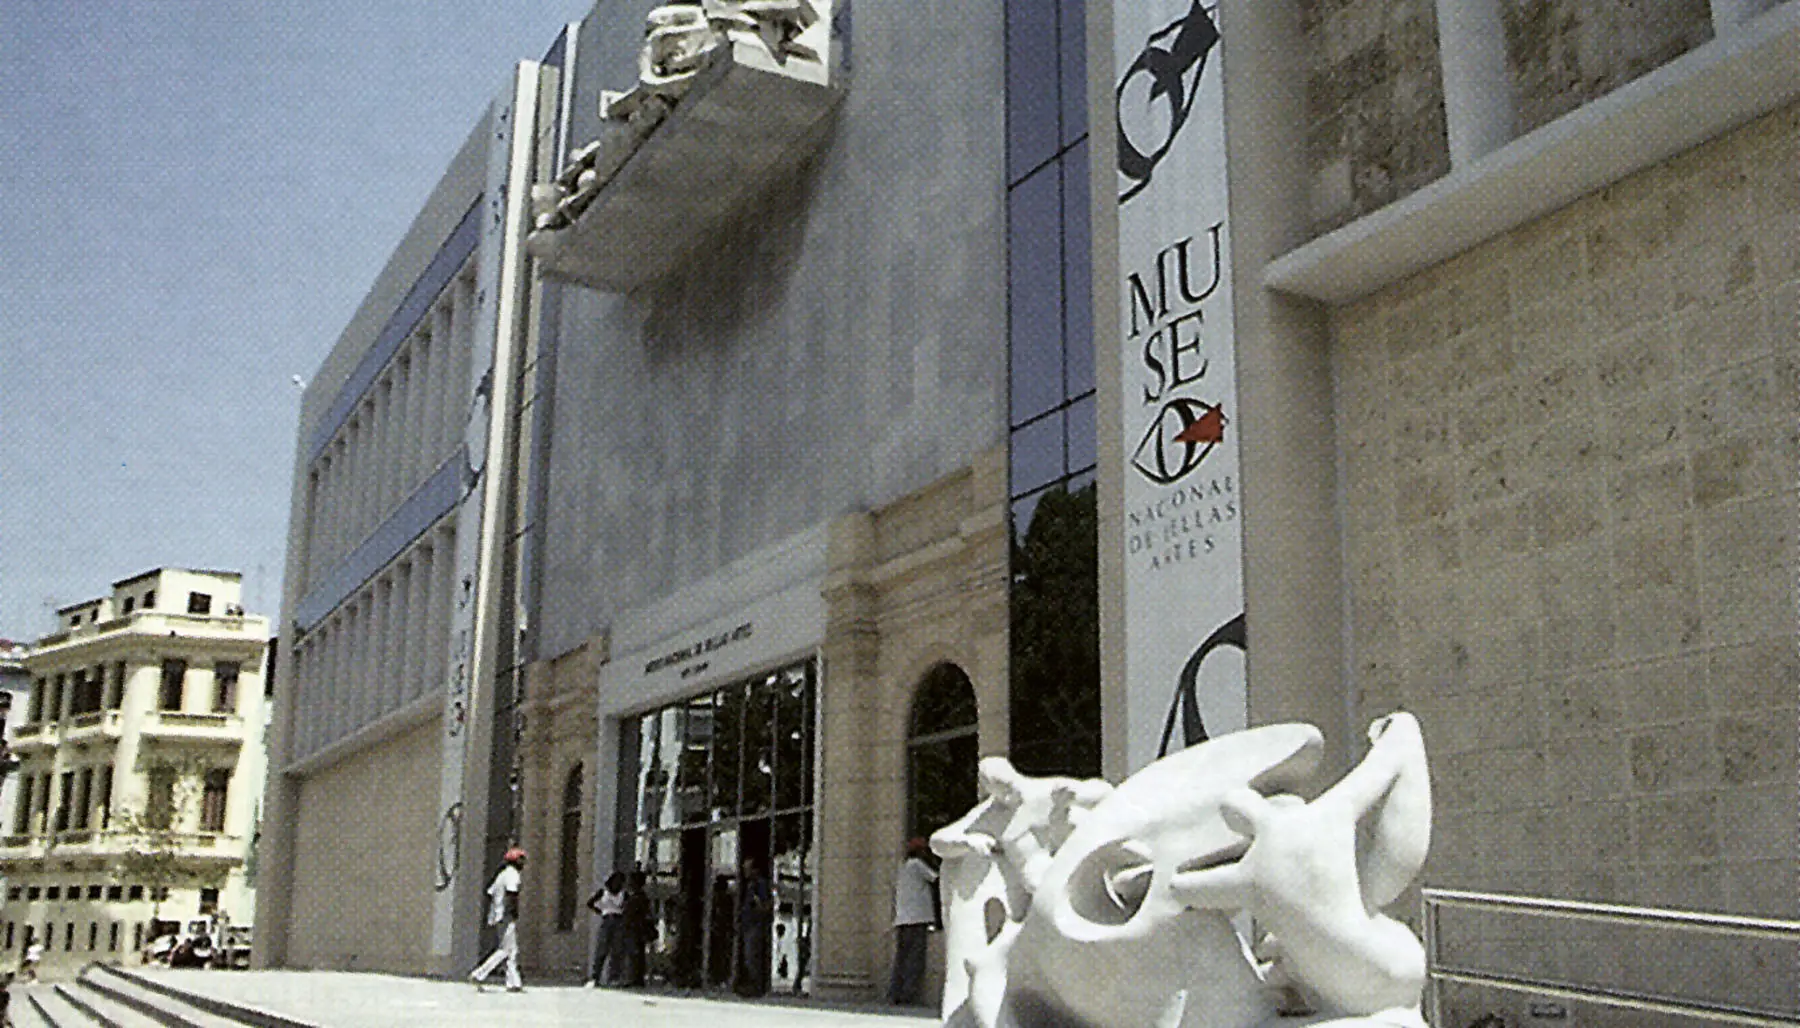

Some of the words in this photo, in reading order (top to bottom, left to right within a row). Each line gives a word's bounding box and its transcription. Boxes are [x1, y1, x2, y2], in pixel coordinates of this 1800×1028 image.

[1127, 221, 1224, 340] MU
[1143, 309, 1209, 406] SE
[1129, 476, 1232, 527] NACONAL
